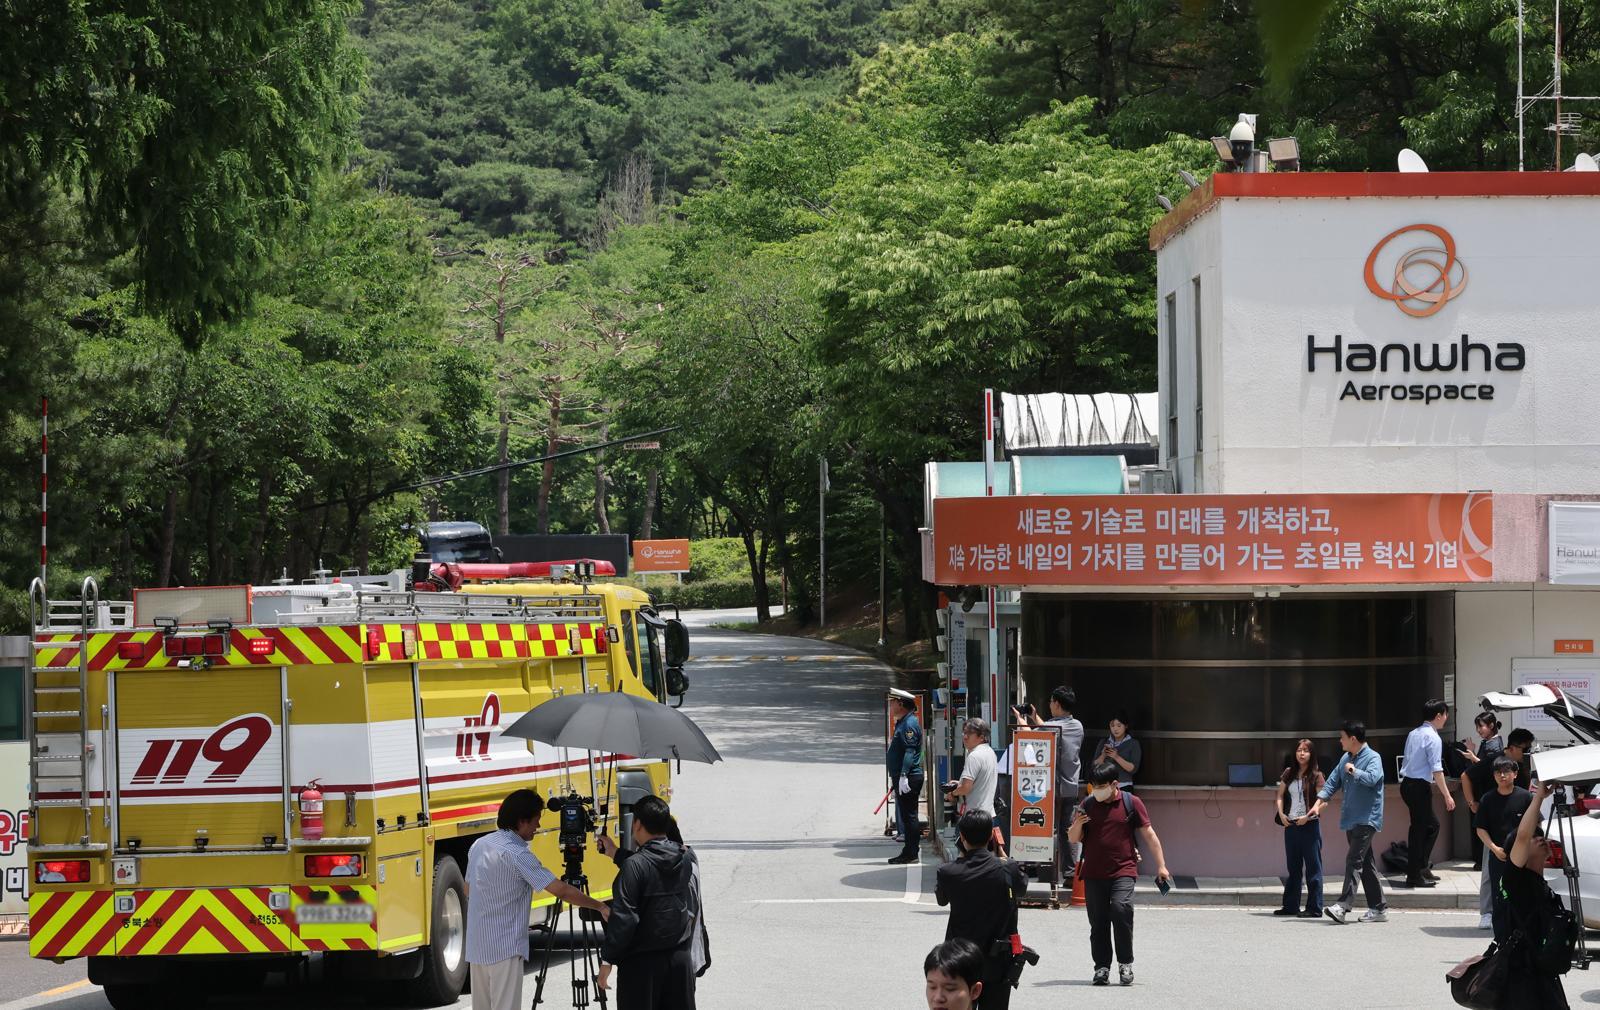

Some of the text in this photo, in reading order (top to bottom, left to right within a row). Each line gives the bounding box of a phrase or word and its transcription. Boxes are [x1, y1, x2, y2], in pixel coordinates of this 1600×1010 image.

[1307, 334, 1526, 372] Hanwha
[1339, 380, 1495, 404] Aerospace
[1017, 506, 1339, 536] 새로운 기술로 미래를 개척하고,
[949, 540, 1458, 572] 지속 가능한 내일의 가치를 만들어 가는 초일류 혁신 기업
[456, 693, 500, 763] 119
[130, 716, 272, 784] 119
